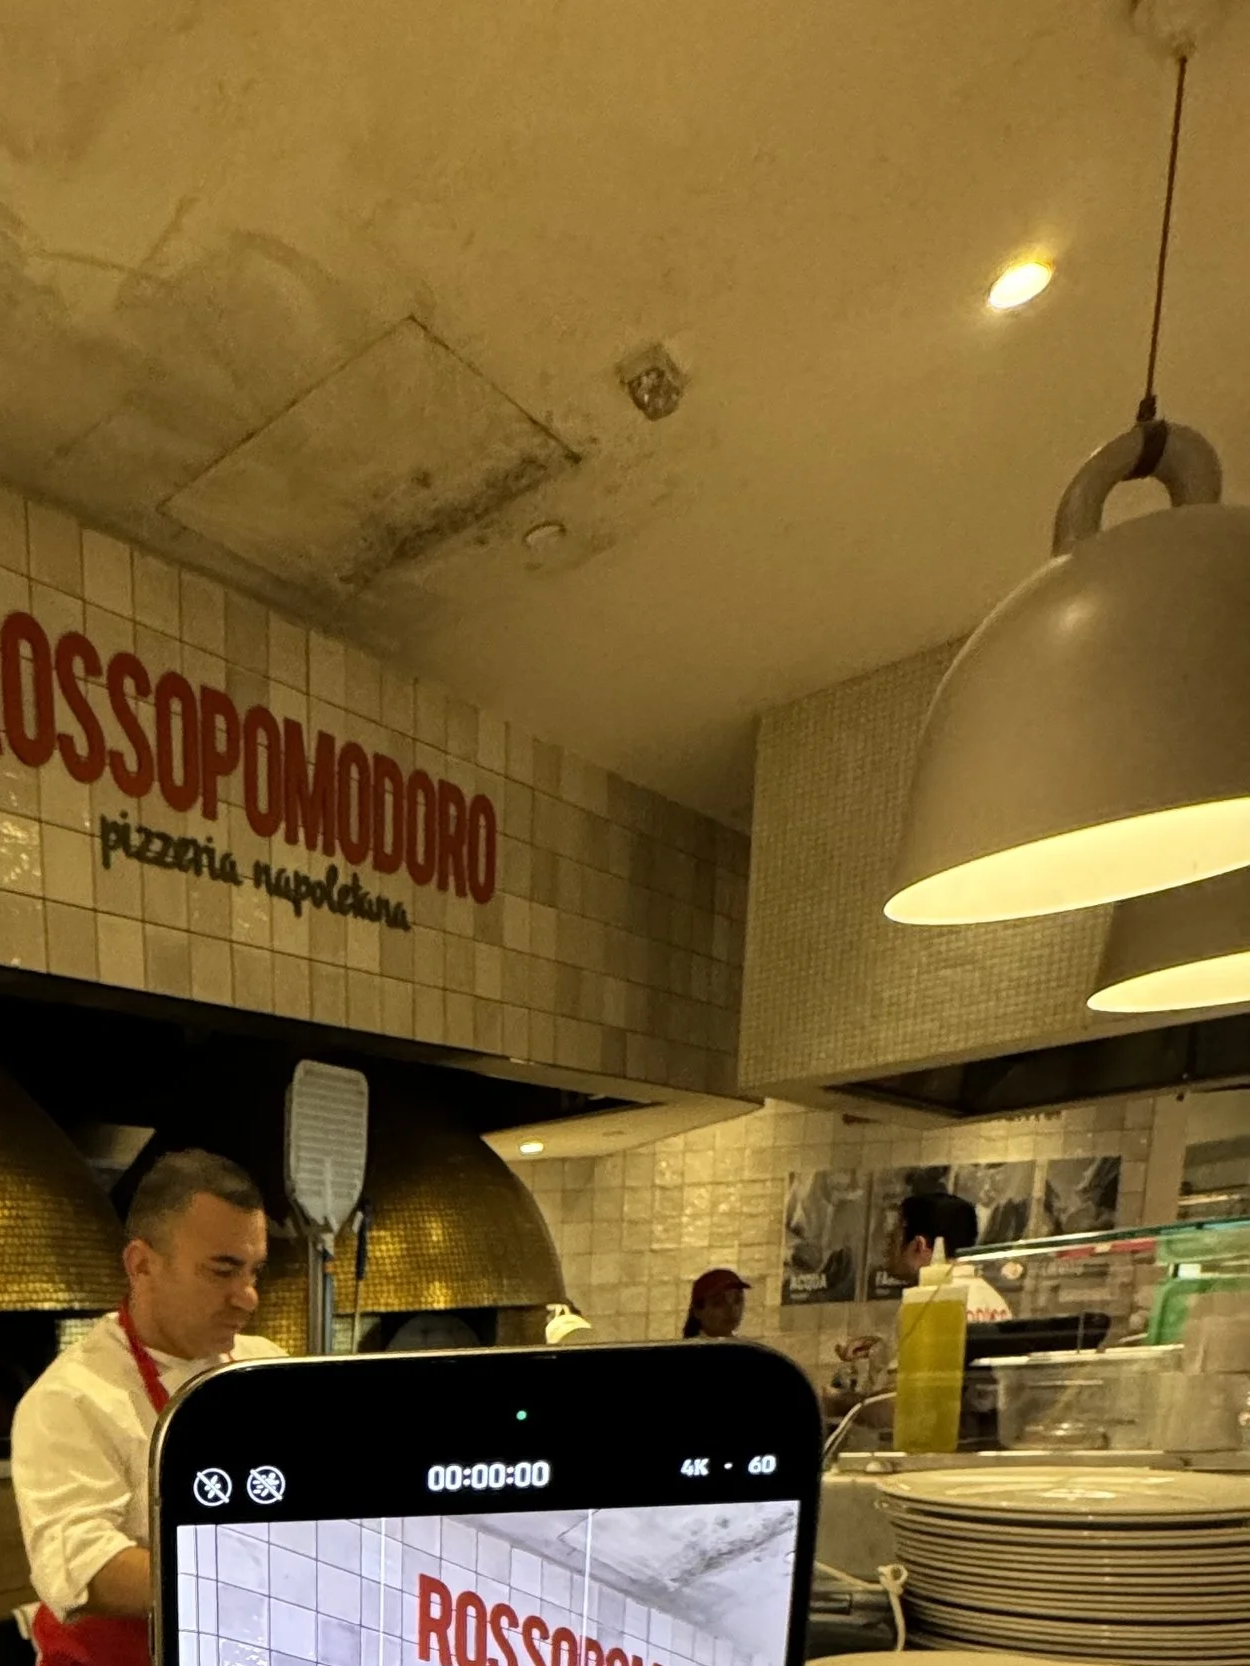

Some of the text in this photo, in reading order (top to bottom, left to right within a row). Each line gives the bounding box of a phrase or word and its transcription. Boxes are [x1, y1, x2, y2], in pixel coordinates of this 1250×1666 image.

[100, 810, 411, 932] pizzeria napoletana
[428, 1461, 550, 1491] 00:00:00
[681, 1455, 777, 1477] 4K 60
